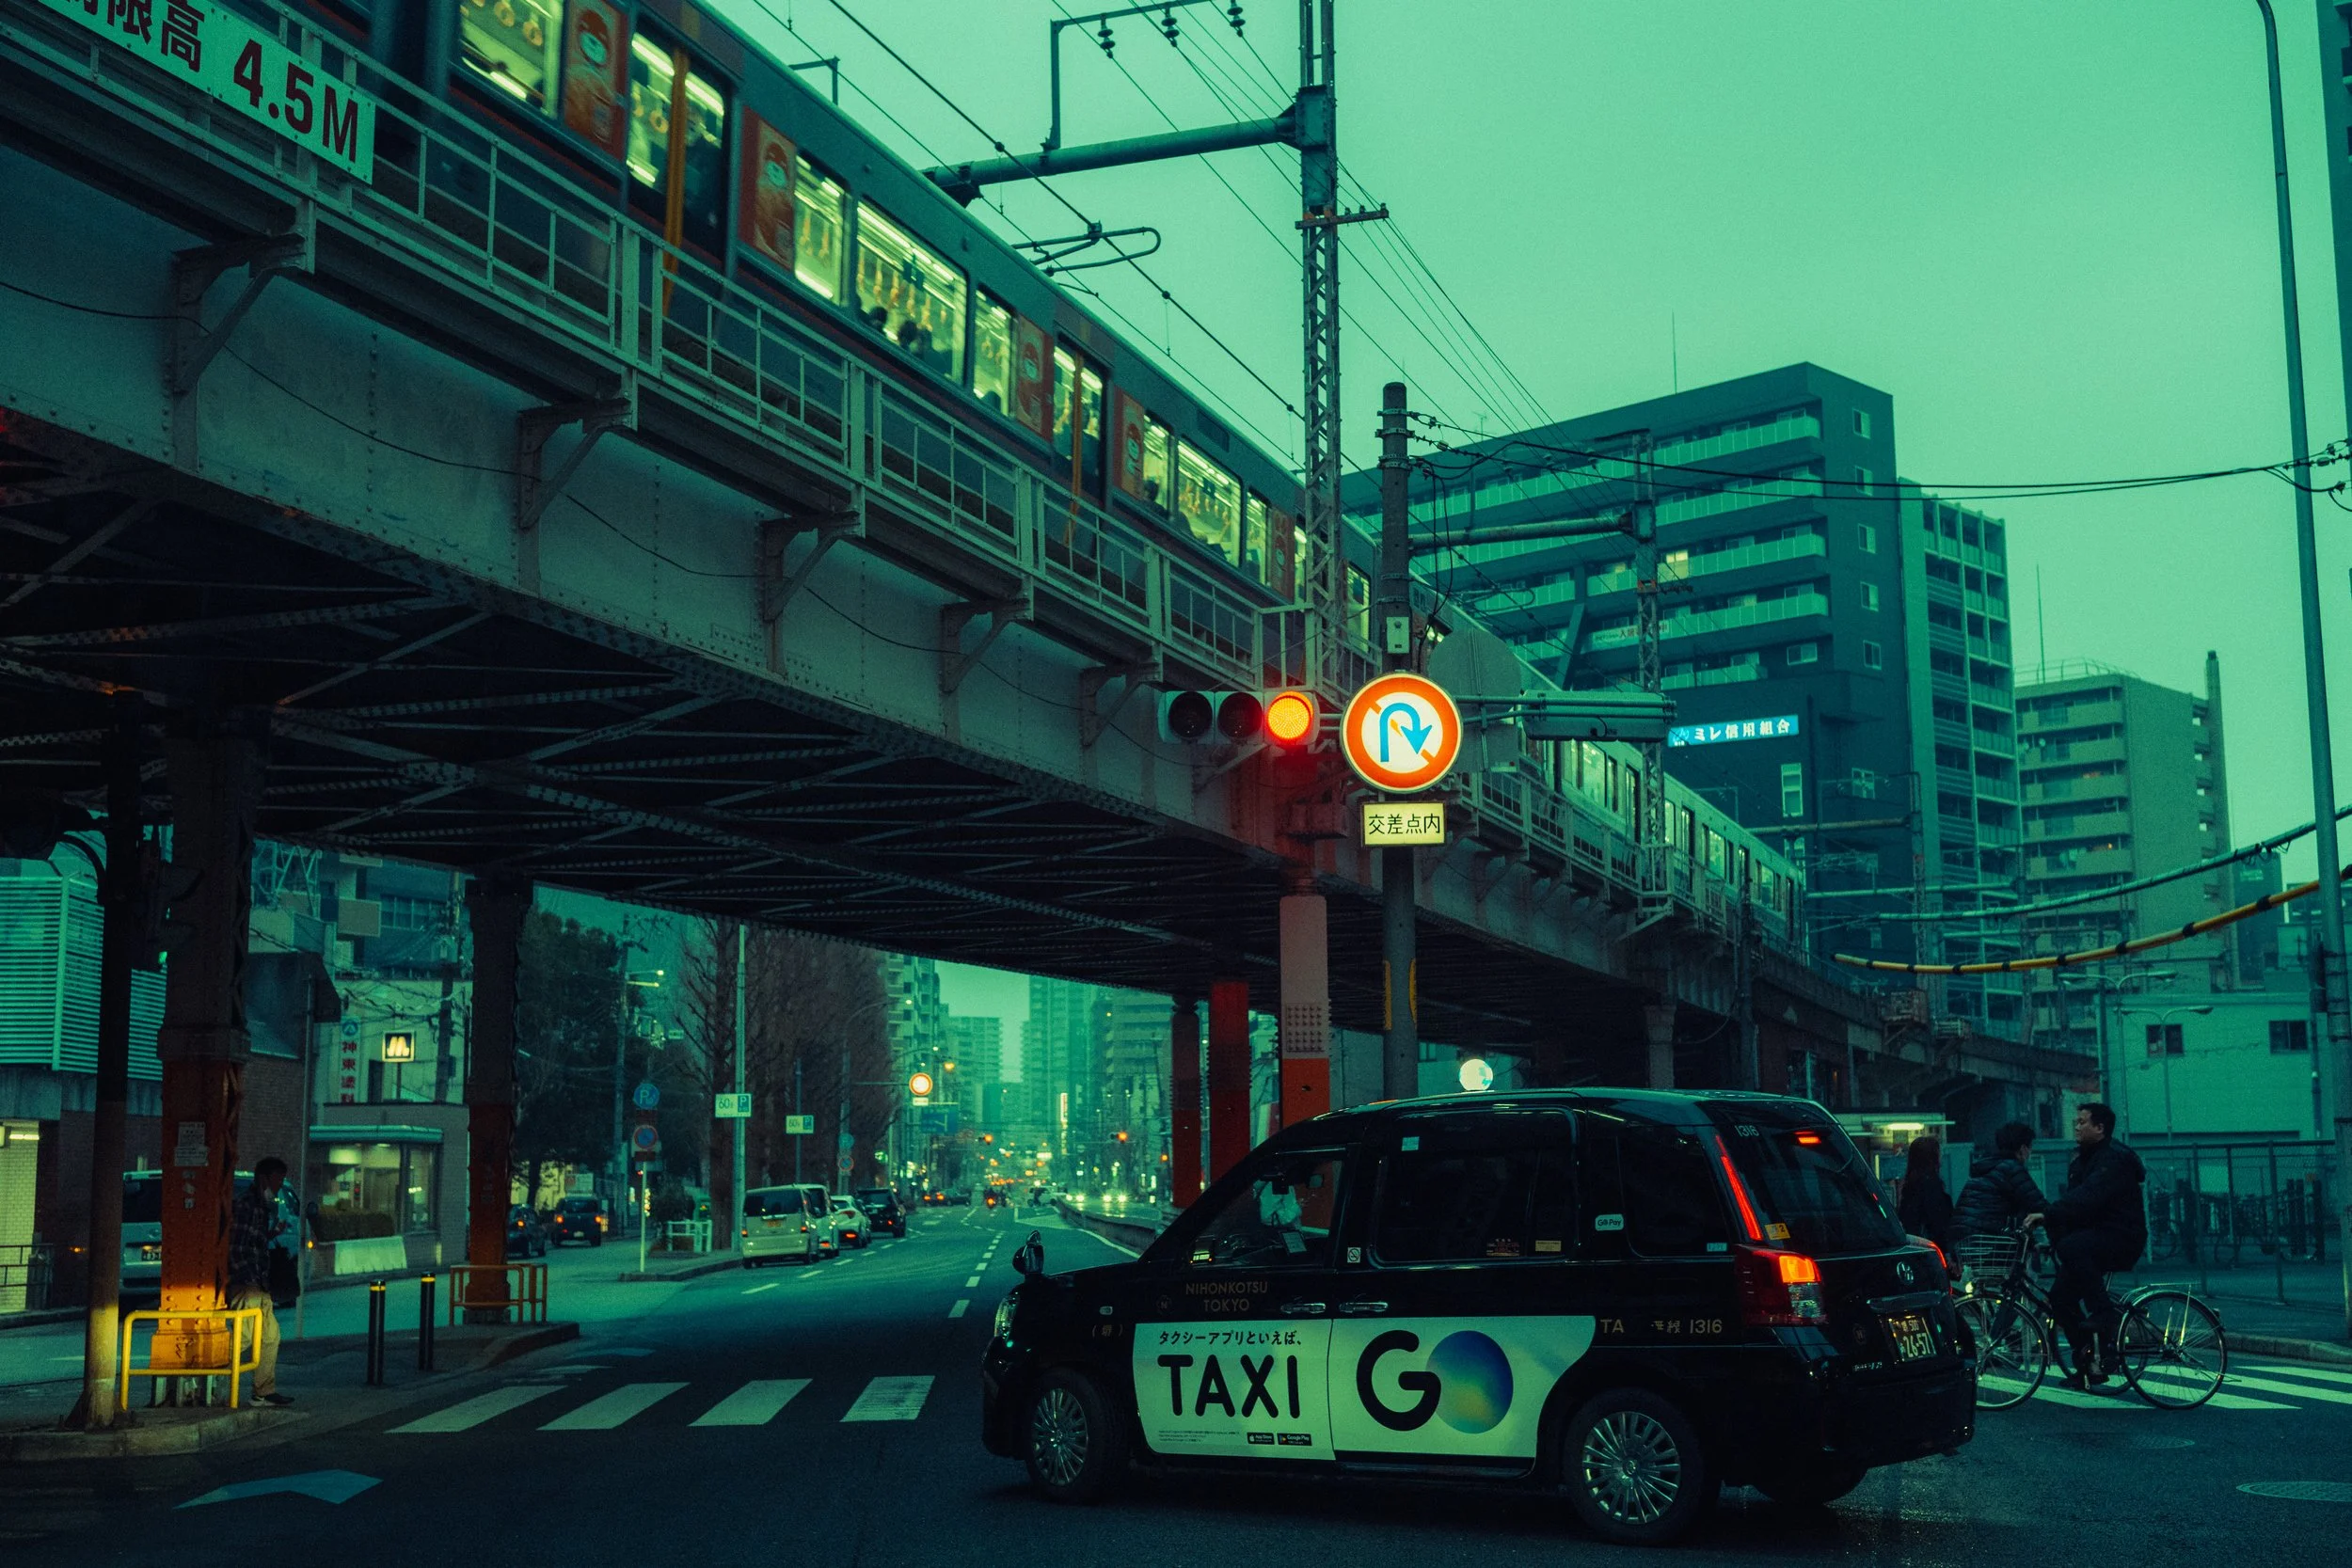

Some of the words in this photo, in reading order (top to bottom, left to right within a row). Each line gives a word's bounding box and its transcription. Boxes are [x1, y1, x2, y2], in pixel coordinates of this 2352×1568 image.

[66, 0, 204, 72] 限高
[233, 39, 359, 164] 4.5M
[1693, 718, 1790, 741] ミレ信用組合
[1368, 813, 1440, 835] 交差点内
[1734, 1125, 1760, 1137] 1316
[1185, 1281, 1268, 1295] NIHONKOTSU
[1203, 1298, 1250, 1312] TOKYO
[1600, 1319, 1625, 1334] TA
[1690, 1319, 1723, 1334] 1316
[1159, 1330, 1302, 1345] タクシーアプリといえば、
[1902, 1332, 1931, 1358] 26-57
[1157, 1354, 1300, 1418] TAXI
